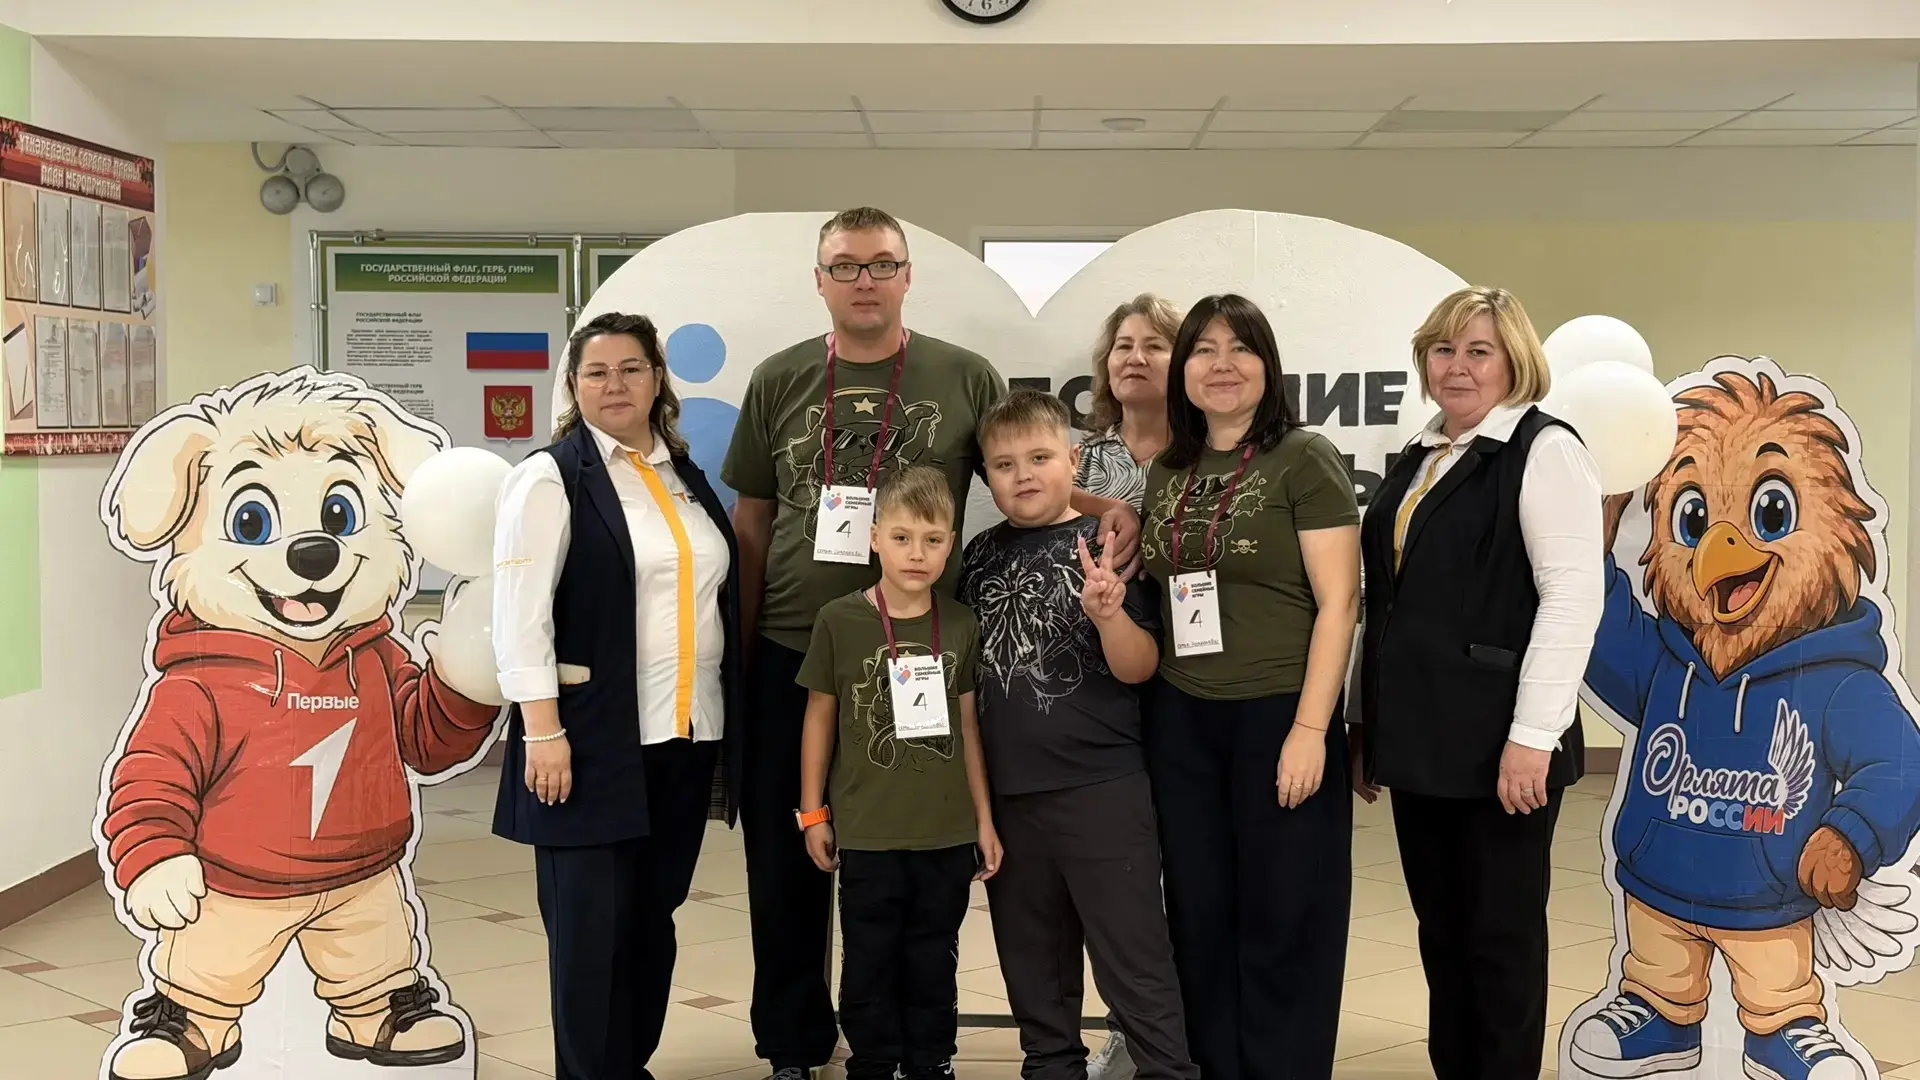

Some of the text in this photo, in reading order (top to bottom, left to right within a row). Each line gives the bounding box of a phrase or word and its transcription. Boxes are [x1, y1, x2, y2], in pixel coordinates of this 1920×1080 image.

[41, 164, 121, 201] ПЛАН МЕРОПРИЯТИЙ
[360, 263, 535, 275] ГОСУДАРСТВЕННЫЙ ФЛАГ, ГЕРБ, ГИМН
[388, 273, 508, 285] РОССИЙСКОЙ ФЕДЕРАЦИИ
[835, 520, 852, 539] 4
[1188, 609, 1203, 628] 4
[287, 692, 360, 714] Первые
[912, 692, 928, 711] 4
[1644, 723, 1780, 811] Орлята
[1670, 795, 1786, 835] РОССИИ
